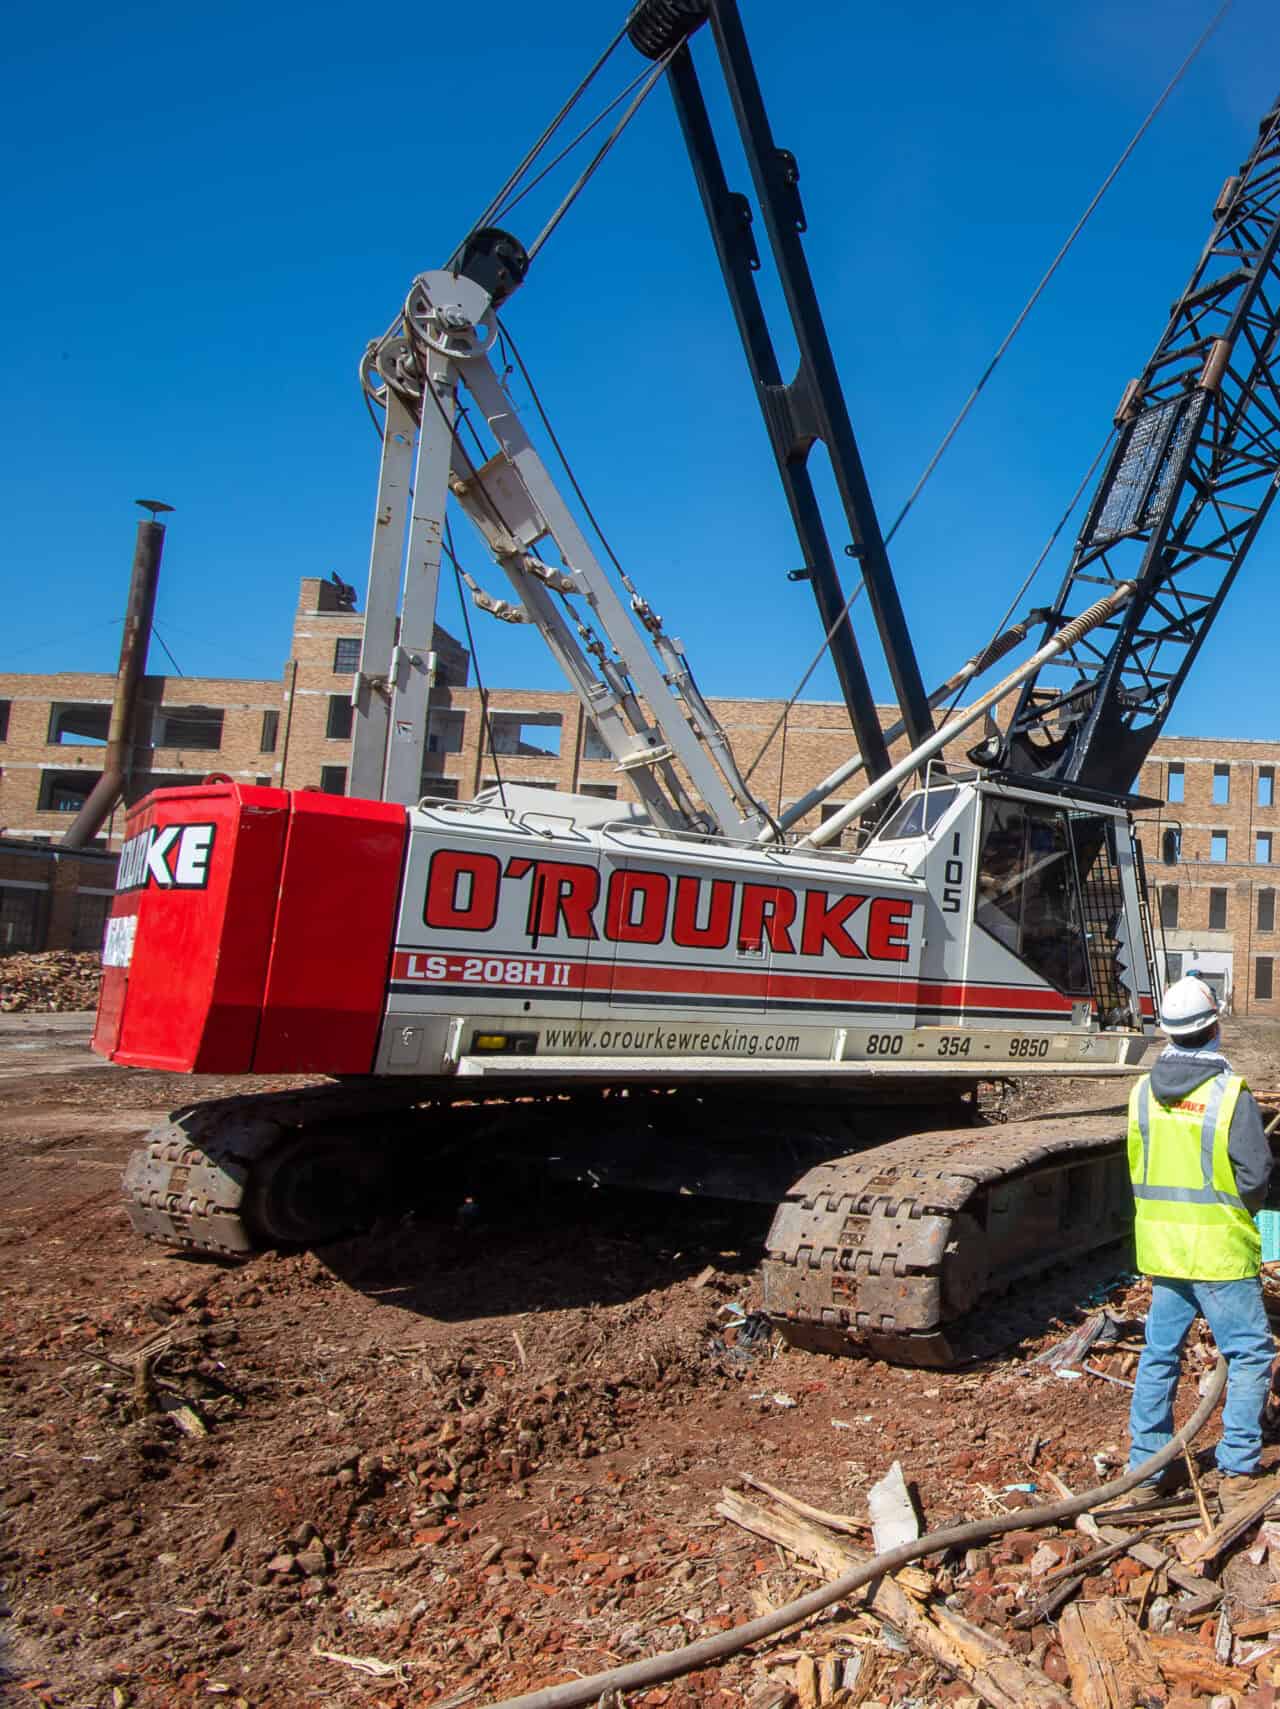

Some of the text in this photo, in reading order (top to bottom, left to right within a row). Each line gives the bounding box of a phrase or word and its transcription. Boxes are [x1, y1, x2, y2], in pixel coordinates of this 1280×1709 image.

[942, 832, 962, 913] 105
[422, 849, 914, 962] O'ROURKE
[407, 955, 571, 986] LS-208H II
[545, 1027, 800, 1055] www.orourkewrecking.com
[866, 1035, 903, 1055] 800
[937, 1036, 972, 1056] 354
[1008, 1037, 1049, 1057] 9850
